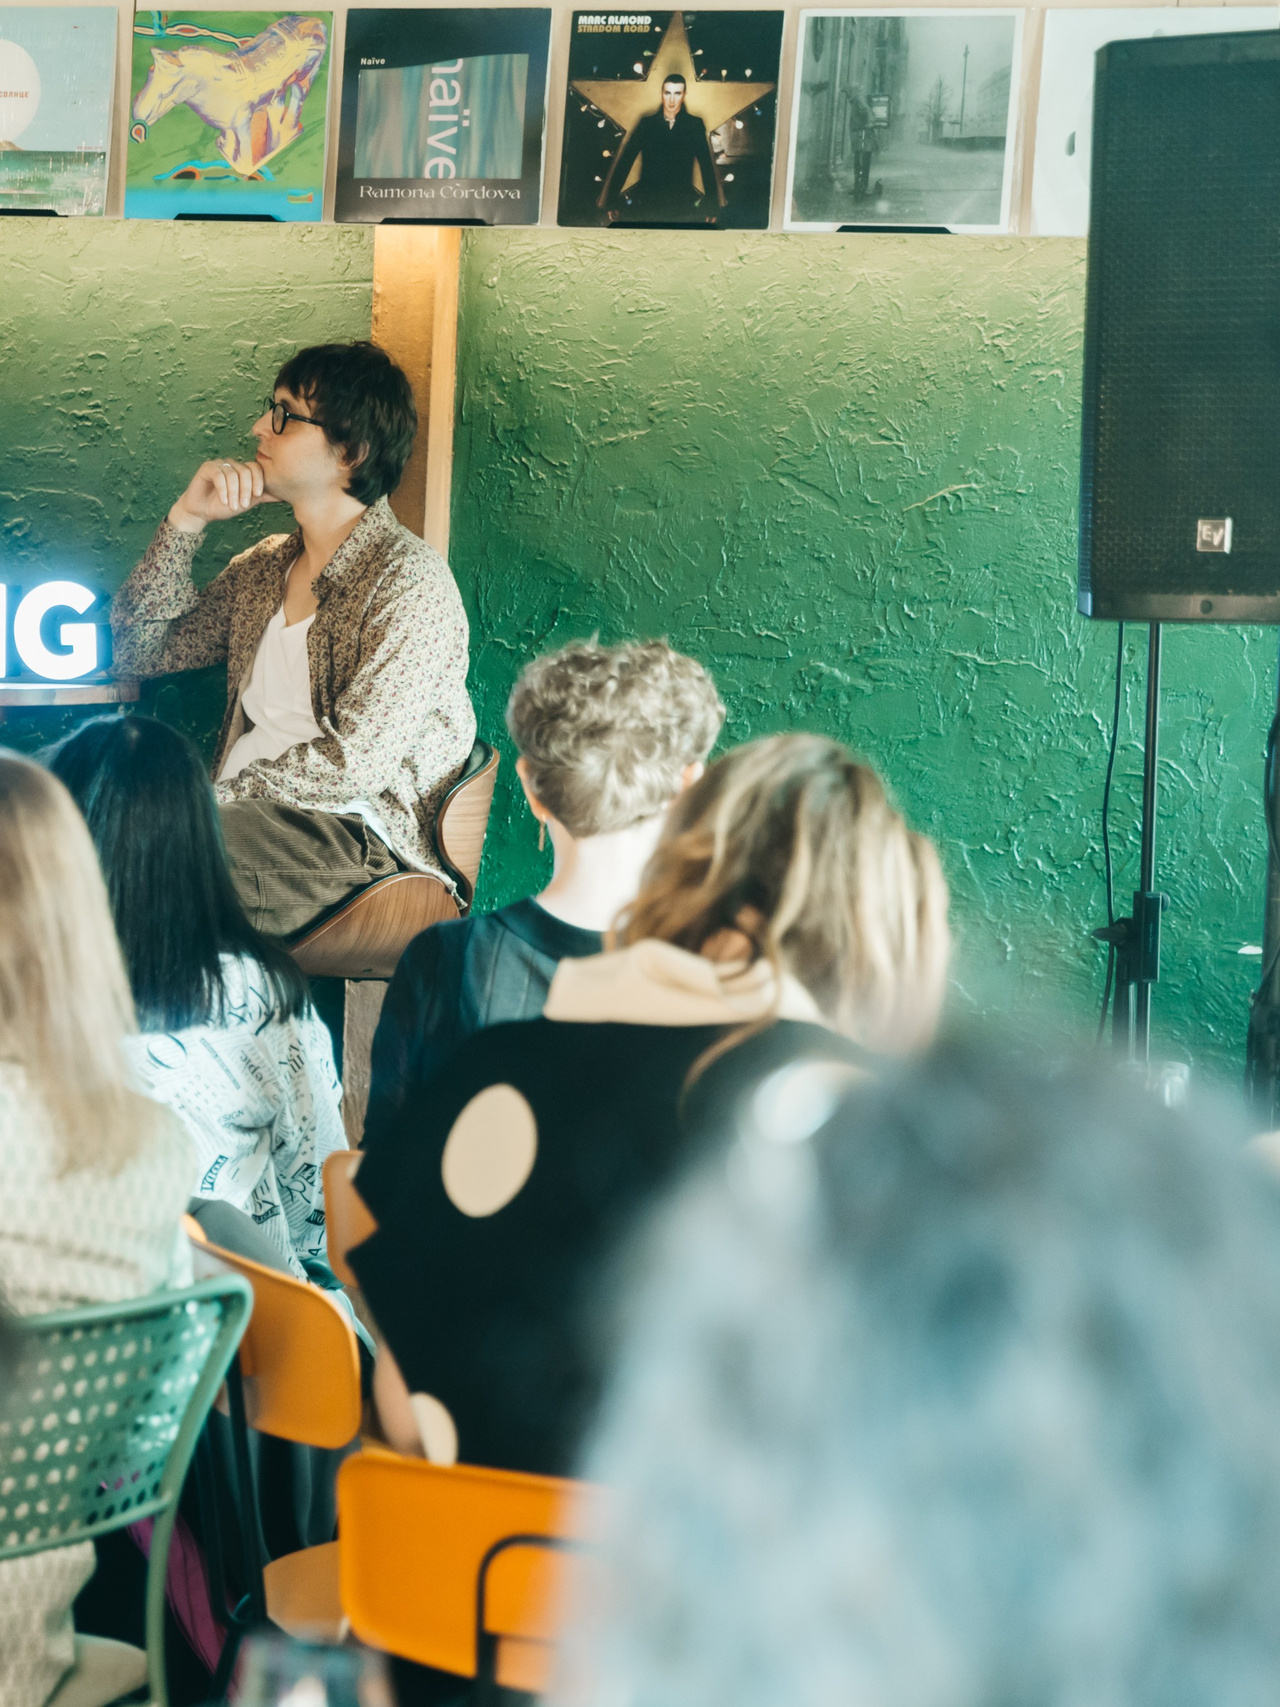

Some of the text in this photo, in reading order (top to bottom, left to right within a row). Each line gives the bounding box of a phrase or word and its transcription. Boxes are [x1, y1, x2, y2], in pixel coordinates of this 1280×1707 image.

[577, 15, 652, 25] MARC ALMOND
[577, 25, 651, 33] STARDOM ROAD
[360, 57, 386, 66] Naïve
[424, 57, 471, 180] naïve
[359, 183, 521, 200] Ramona Còrdova
